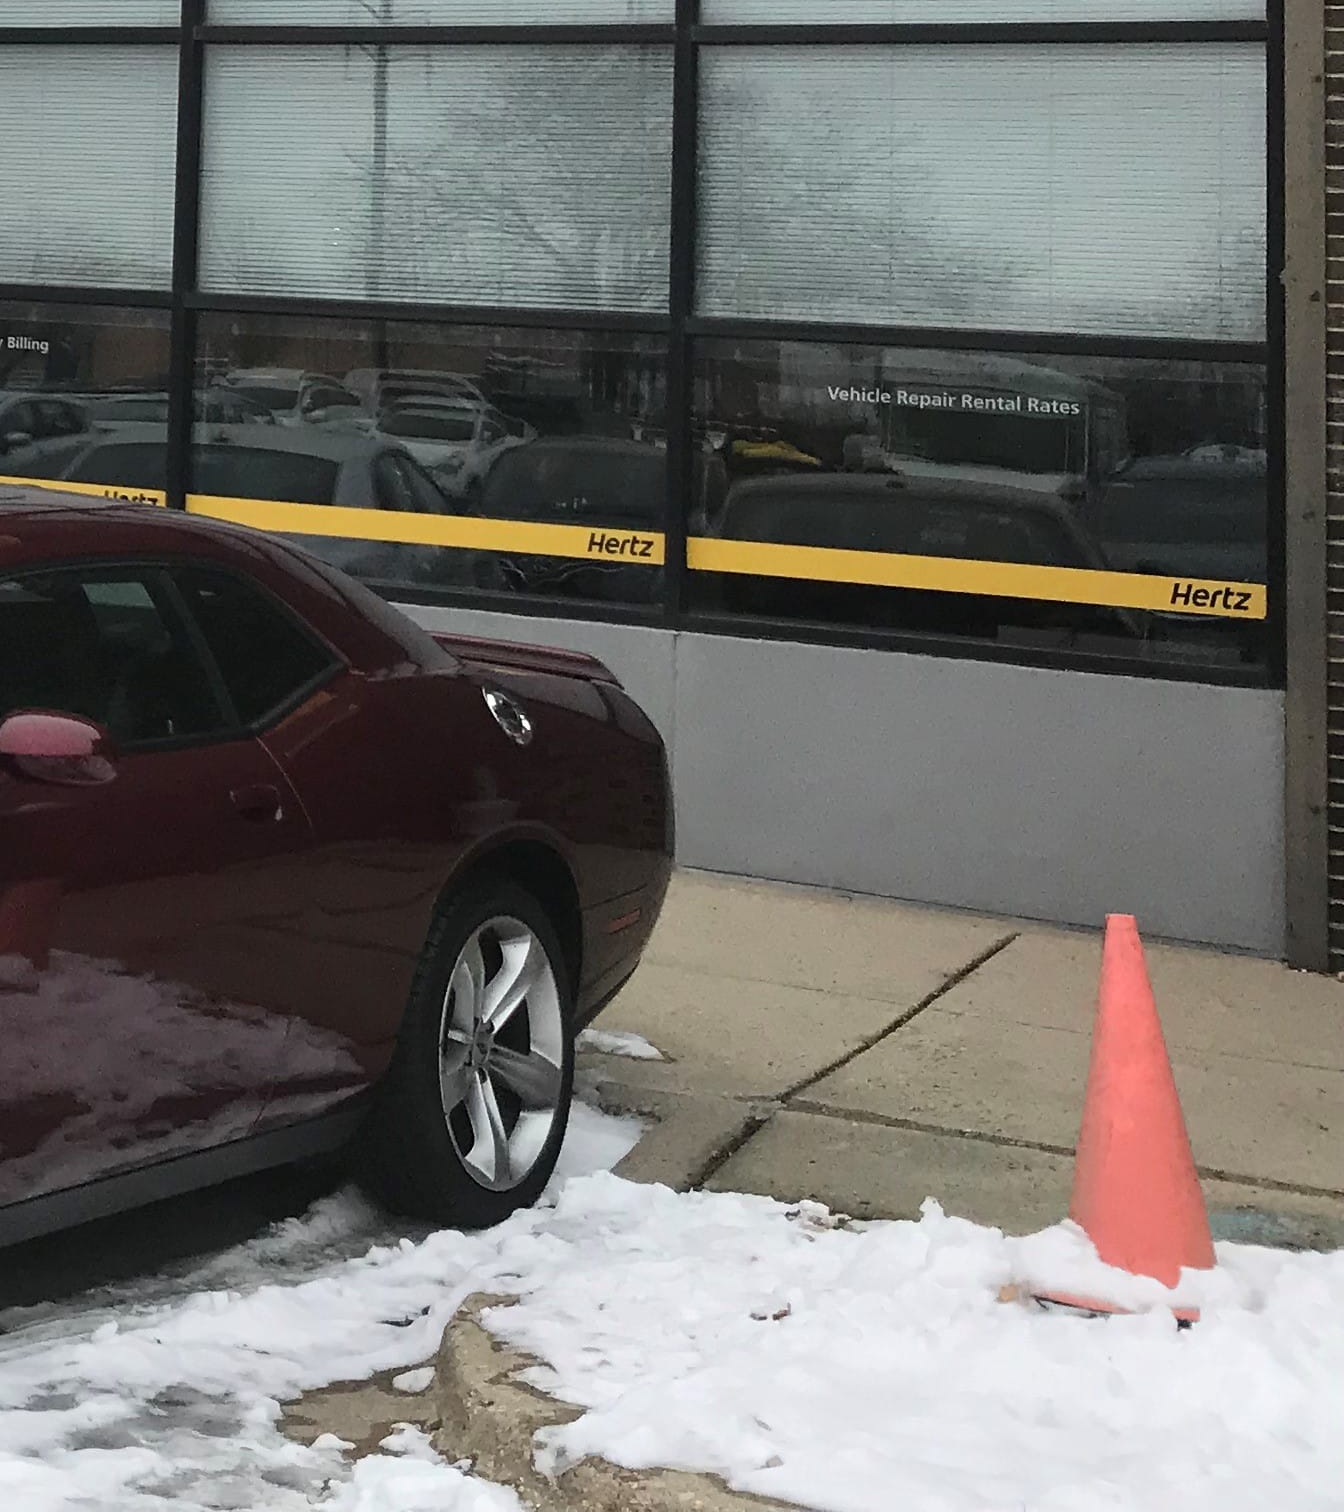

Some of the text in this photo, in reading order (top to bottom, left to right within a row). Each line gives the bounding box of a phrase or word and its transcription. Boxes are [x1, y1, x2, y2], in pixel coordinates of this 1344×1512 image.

[7, 336, 49, 354] Billing
[827, 386, 1081, 416] Vehicle Repair Rental Rates
[587, 532, 654, 557] Hertz
[1170, 582, 1252, 611] Hertz
